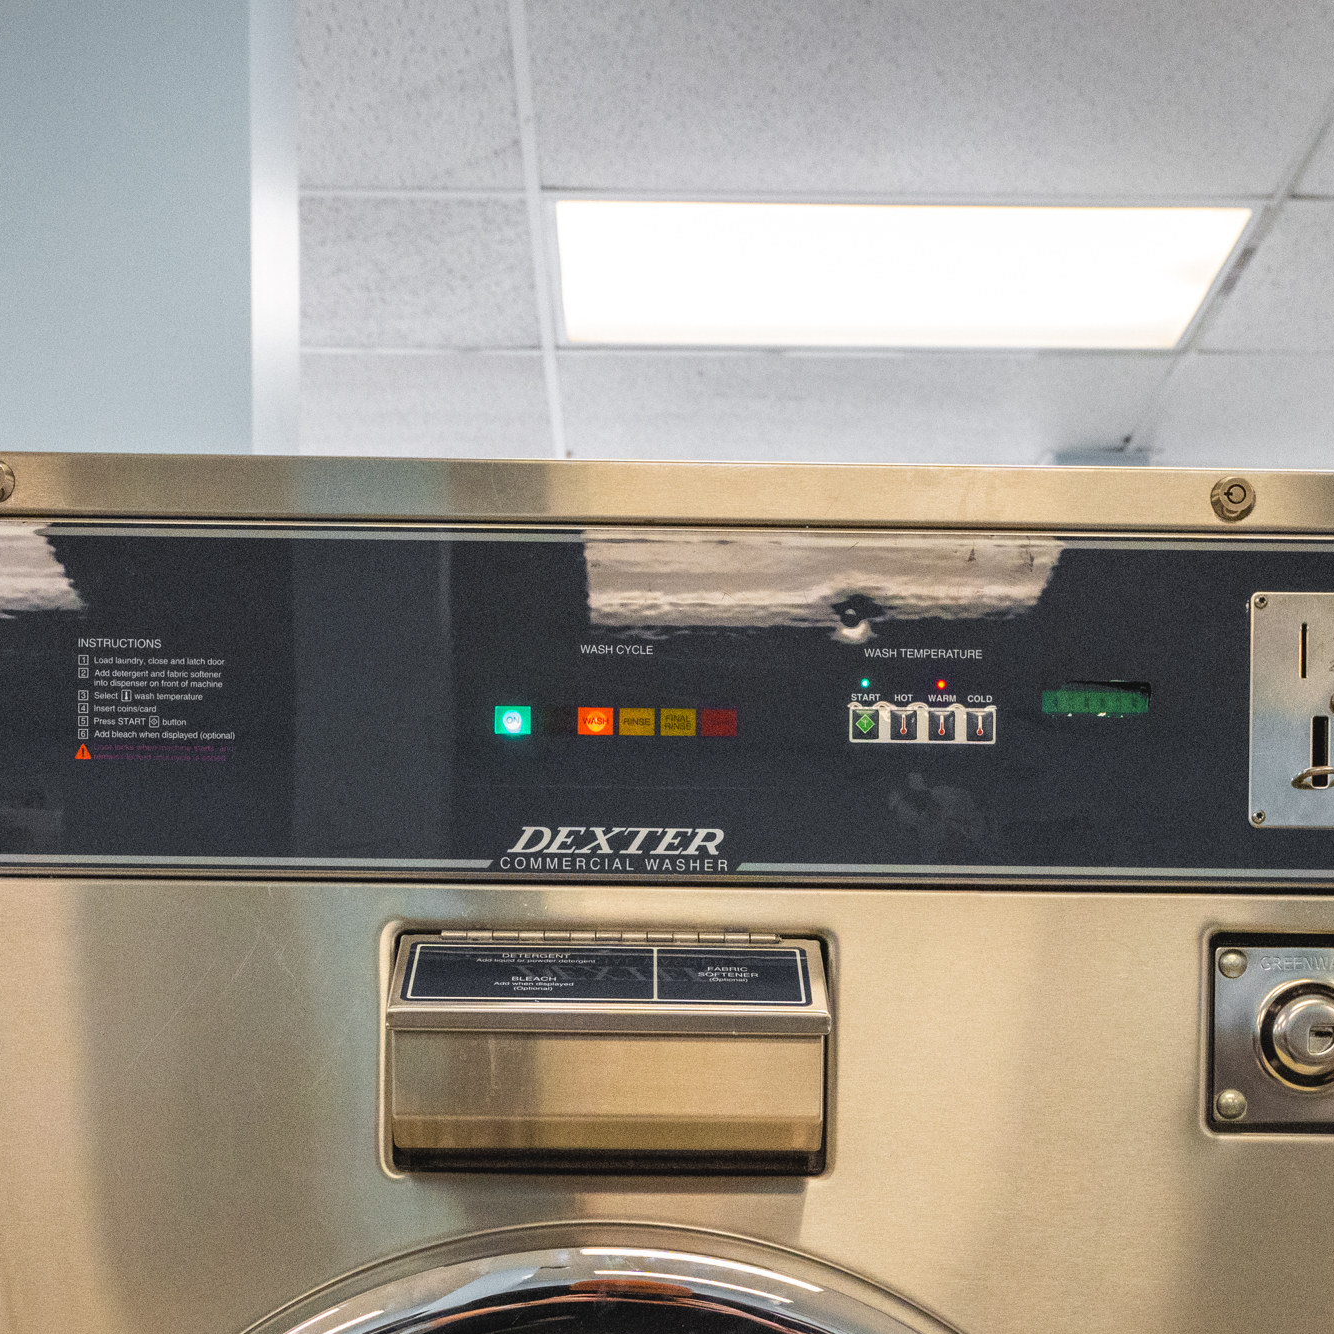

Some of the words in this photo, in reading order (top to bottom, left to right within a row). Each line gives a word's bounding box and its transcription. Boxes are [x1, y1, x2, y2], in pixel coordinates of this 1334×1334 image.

[78, 638, 162, 649] INSTRUCTIONS
[580, 644, 613, 655] WASH
[615, 644, 654, 655] CYCLE
[864, 648, 897, 659] WASH
[900, 648, 983, 659] TEMPERATURE
[850, 693, 881, 701] START
[894, 694, 913, 702] HOT
[928, 694, 957, 702] WARM
[967, 695, 993, 703] COLD
[582, 717, 609, 725] WASH
[623, 717, 651, 726] RINSE
[506, 826, 725, 855] DEXTER
[500, 856, 634, 871] COMMERCIAL
[644, 858, 728, 872] WASHER
